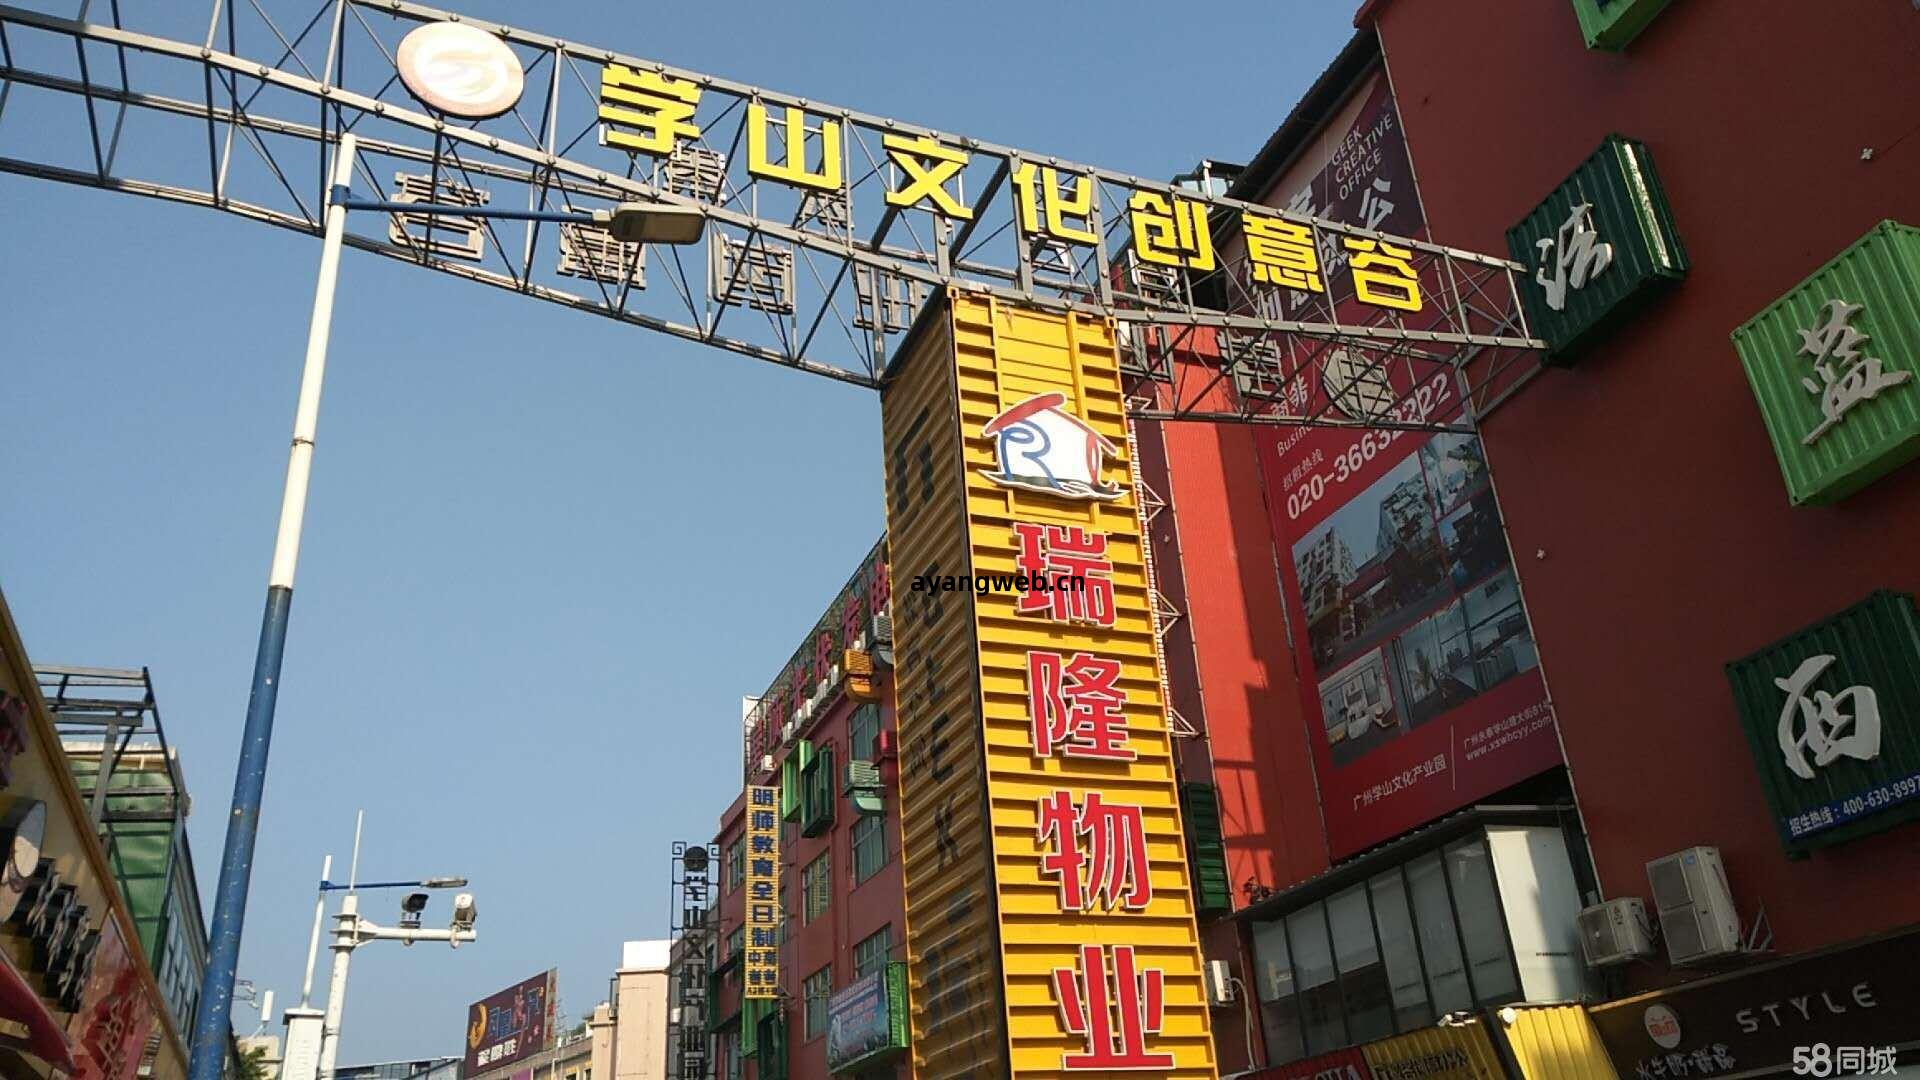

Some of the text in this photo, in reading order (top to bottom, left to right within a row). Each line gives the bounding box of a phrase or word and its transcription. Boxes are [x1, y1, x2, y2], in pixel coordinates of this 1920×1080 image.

[1331, 125, 1363, 167] GEEK
[1335, 113, 1393, 184] CREATIVE
[1339, 147, 1383, 201] OFFICE
[598, 63, 1423, 313] 学山文化创意谷
[1013, 522, 1176, 1071] 瑞隆物业
[1735, 981, 1878, 1034] STYLE
